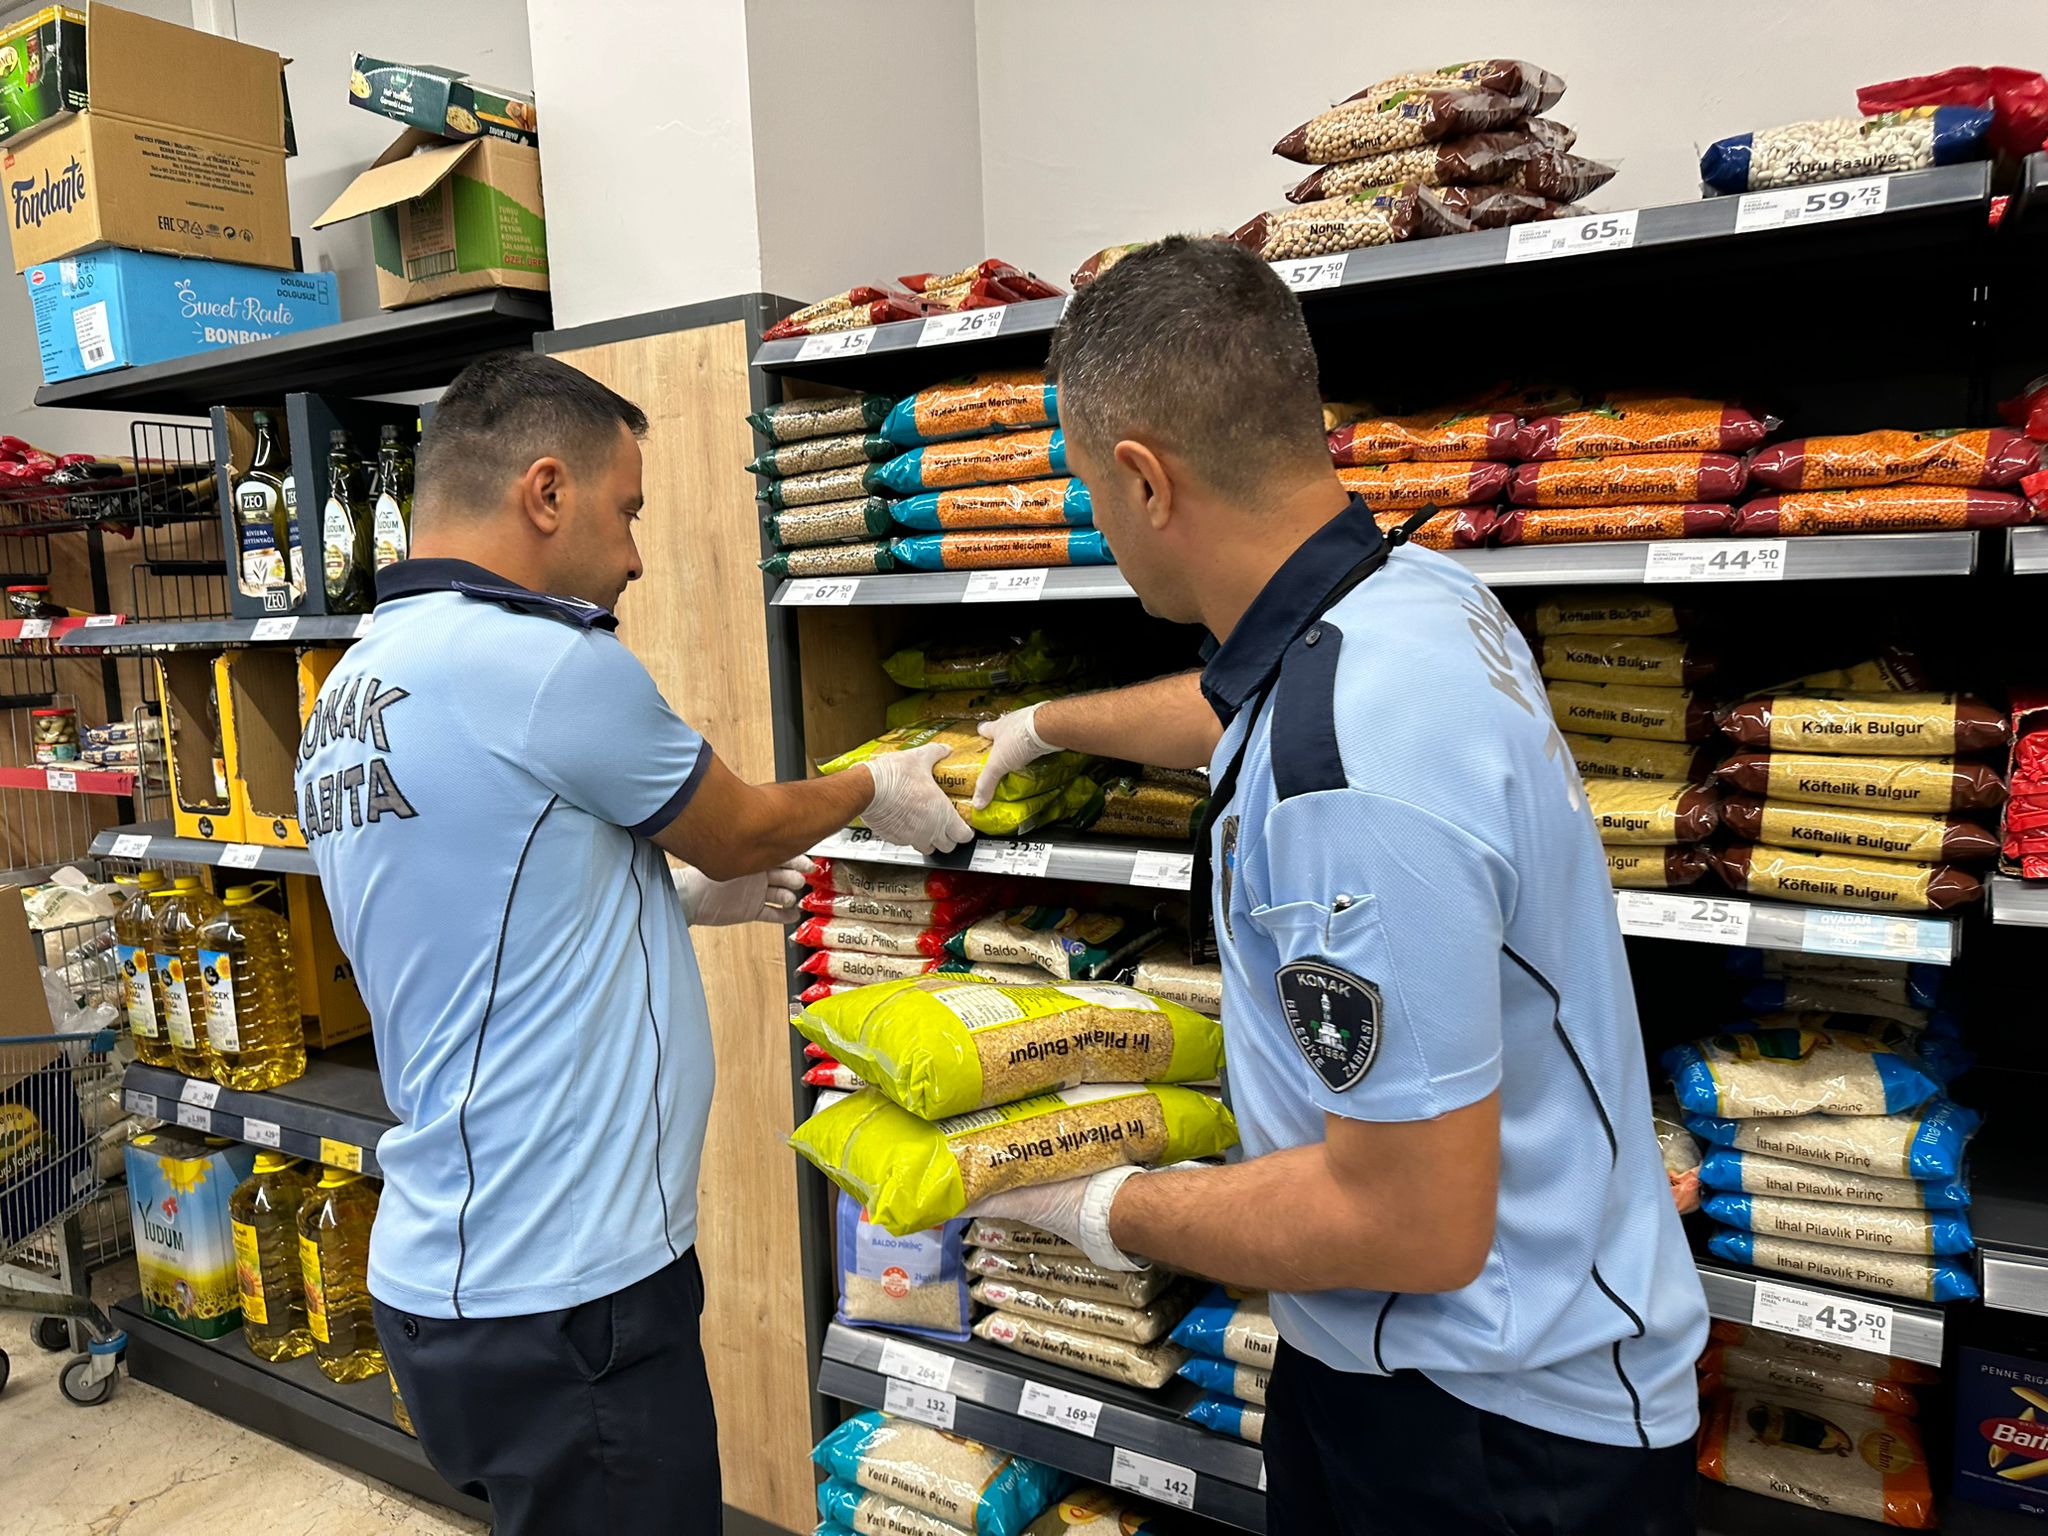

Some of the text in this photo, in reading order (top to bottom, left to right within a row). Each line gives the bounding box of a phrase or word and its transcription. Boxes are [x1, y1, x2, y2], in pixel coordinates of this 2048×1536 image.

[1788, 152, 1898, 175] Kuru Fasulye
[1361, 174, 1394, 190] Nohut
[11, 155, 86, 230] Fondanté
[1804, 185, 1882, 213] 59,75 TL
[1309, 222, 1345, 236] Nohut
[1580, 219, 1632, 241] 65 TL
[1289, 261, 1343, 284] 57,50 TL
[280, 277, 315, 290] DOLGULU
[276, 288, 317, 302] DOLGUSUZ
[178, 288, 294, 326] Sweet Route
[958, 311, 1001, 332] 26,50
[840, 333, 865, 349] 15
[1575, 436, 1700, 453] Kırmızı Mercimek
[1554, 481, 1678, 498] Kırmızı Mercimek
[243, 496, 263, 508] ZEO
[1540, 520, 1665, 538] Kırmızı Mercimek
[1861, 515, 1942, 530] Mercimek
[1708, 548, 1780, 570] 44,50 TL
[266, 592, 285, 609] ZEO
[1609, 608, 1652, 622] Bulgur
[1616, 654, 1662, 671] Bulgur
[297, 677, 411, 766] ONAK
[1569, 705, 1665, 728] Köftelik Bulgur
[1867, 721, 1924, 738] Bulgur
[1798, 778, 1921, 801] Köftelik Bulgur
[297, 758, 420, 843] ABITA
[1602, 815, 1650, 832] Bulgur
[1791, 825, 1912, 853] Köftelik Bulgur
[1606, 855, 1640, 870] ulgur
[1777, 876, 1899, 903] Köftelik Bulgur
[848, 902, 880, 916] Baldo
[1690, 899, 1743, 925] 25 TL
[983, 942, 1018, 957] Baldo
[842, 961, 874, 976] Baldo
[1296, 973, 1352, 999] KONAK
[1008, 1038, 1068, 1066] Bulgur
[1056, 1122, 1123, 1153] Pilavlık
[1126, 1119, 1144, 1139] İri
[1756, 1135, 1871, 1168] İthal Pilavlık Pirinç
[1766, 1176, 1884, 1202] İthal Pilavlık Pirinç
[137, 1199, 185, 1253] YUDUM
[1775, 1216, 1893, 1246] İthal Pilavlık Pirinç
[871, 1238, 923, 1253] BALDO PİRİNÇ
[1777, 1254, 1895, 1288] İthal Pilavlık Pirinç
[1815, 1305, 1887, 1341] 43,50 TL
[1244, 1335, 1272, 1354] İthal
[1981, 1364, 2020, 1380] PENNE
[926, 1398, 946, 1413] 132
[867, 1466, 958, 1513] Yerli Pilavlık Pirinç
[1164, 1477, 1189, 1496] 142
